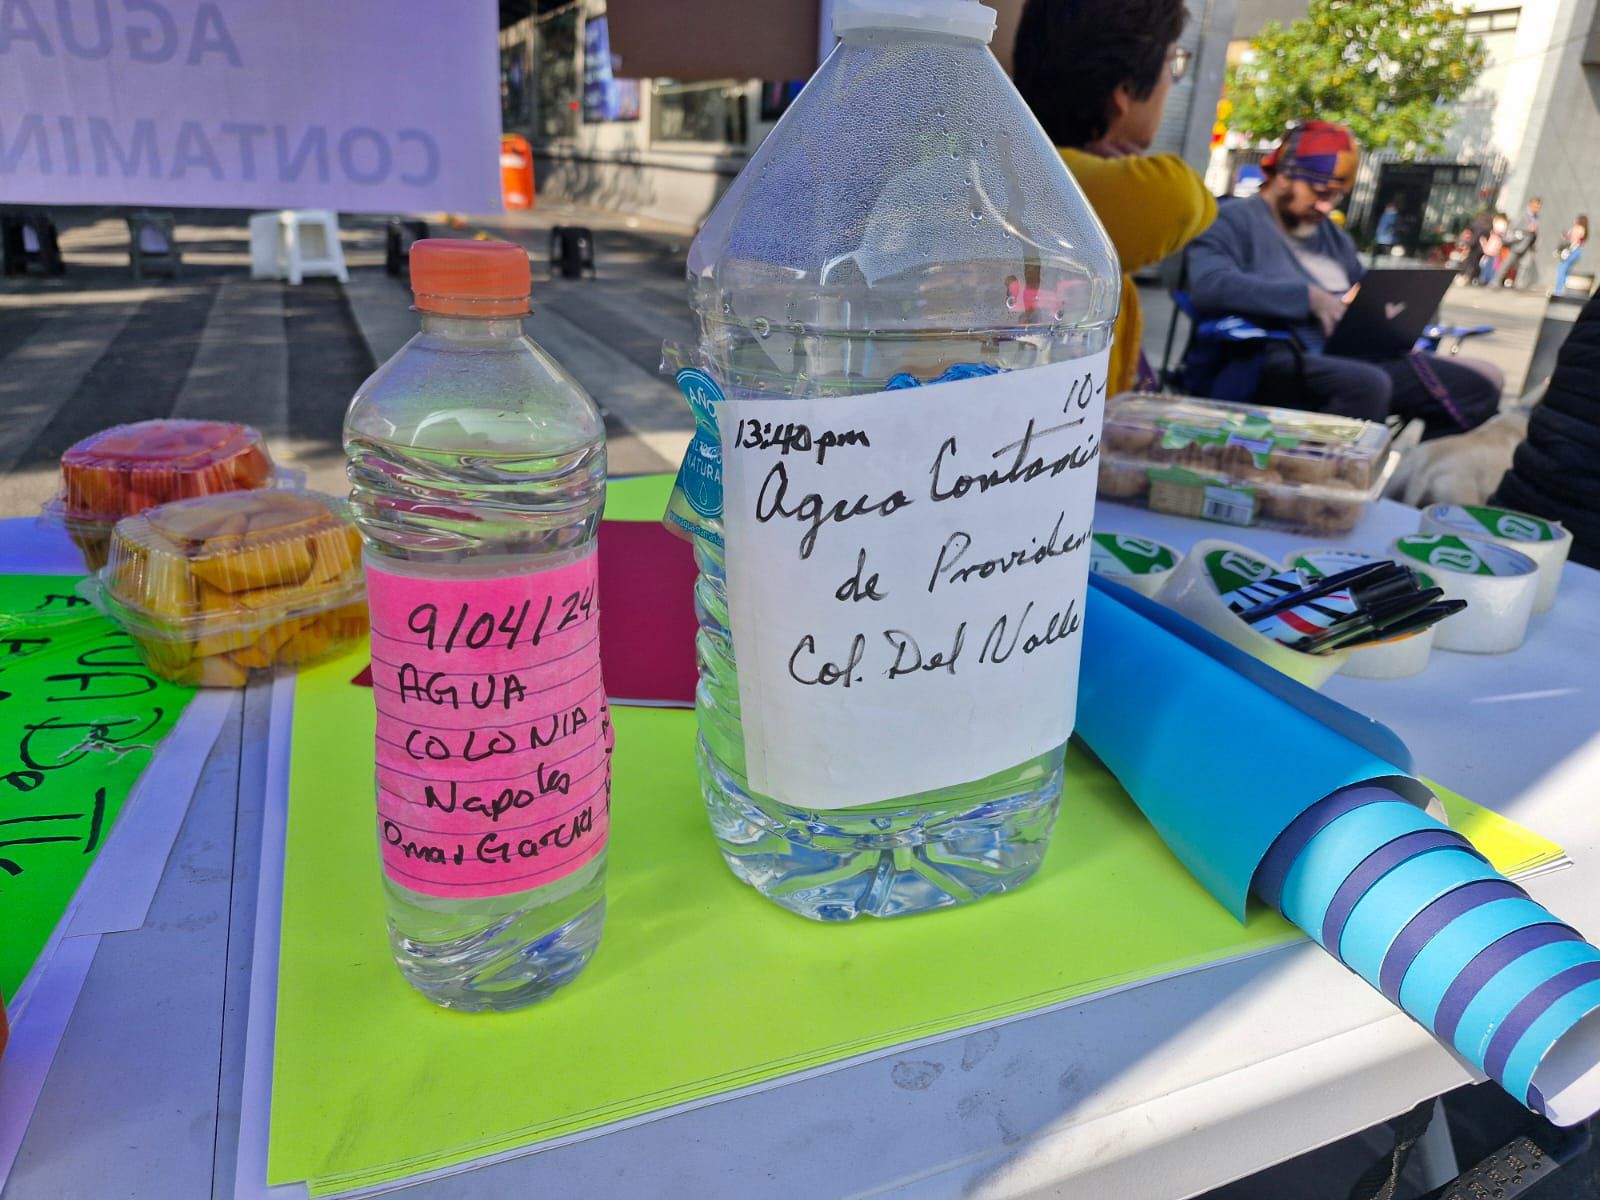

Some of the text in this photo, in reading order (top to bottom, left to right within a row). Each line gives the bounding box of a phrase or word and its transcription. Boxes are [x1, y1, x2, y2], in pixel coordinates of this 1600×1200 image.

[686, 453, 722, 485] NATURA
[756, 462, 912, 559] Agua
[835, 548, 888, 602] de
[883, 622, 967, 680] Del
[398, 663, 527, 709] AGUA
[406, 707, 588, 762] COLONIA
